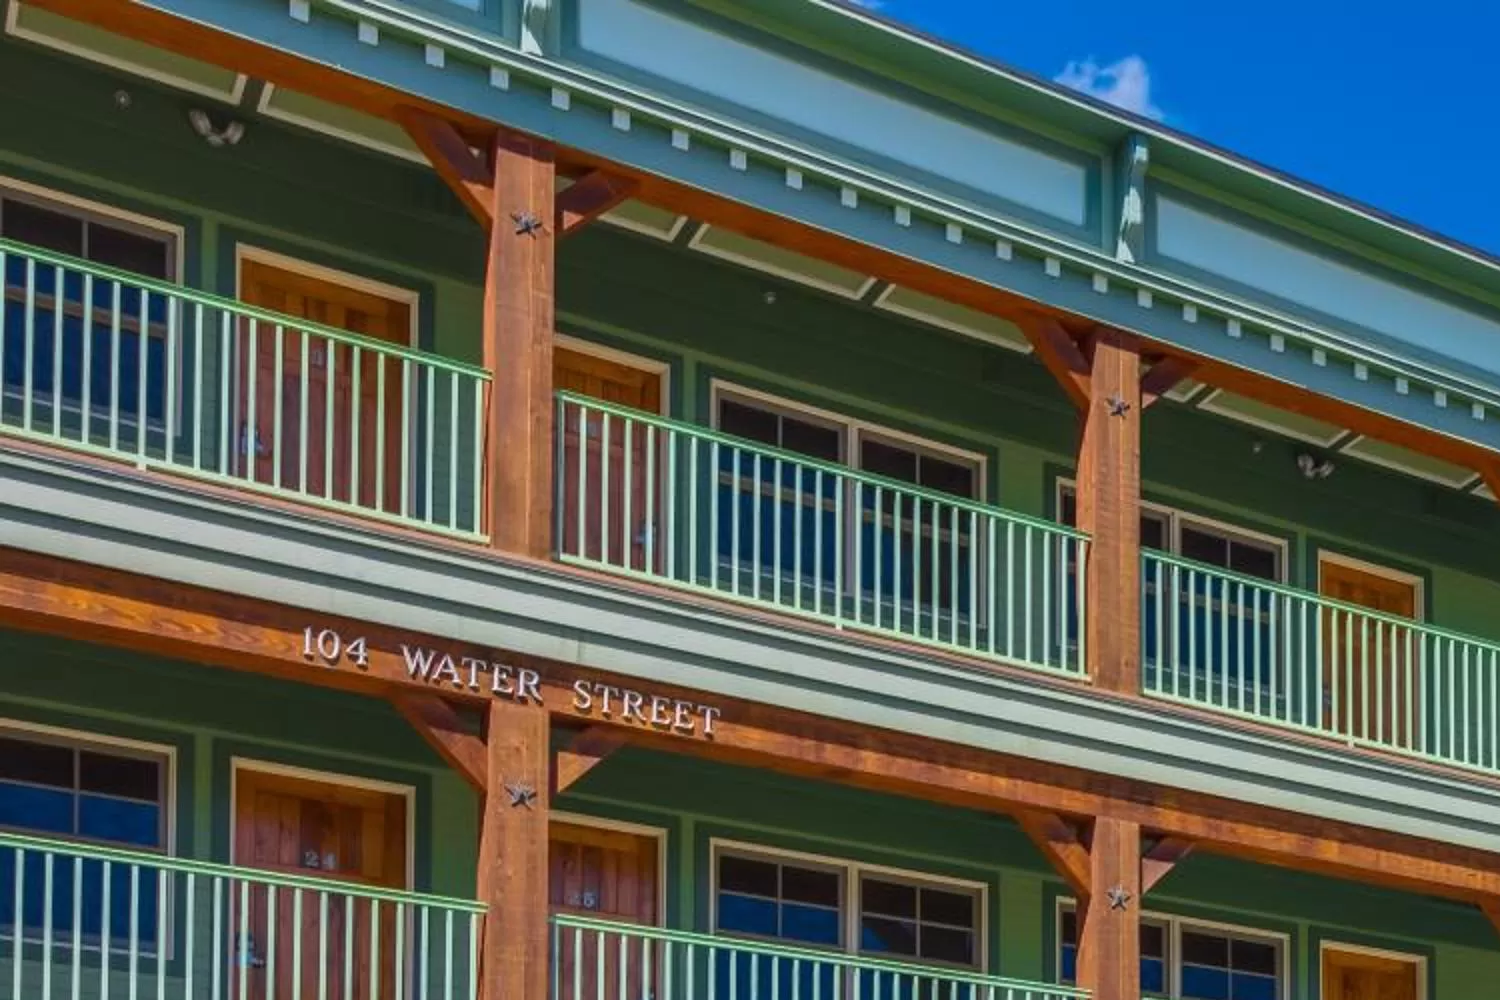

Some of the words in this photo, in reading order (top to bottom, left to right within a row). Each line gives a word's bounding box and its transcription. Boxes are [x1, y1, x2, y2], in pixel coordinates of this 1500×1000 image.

[302, 626, 369, 668] 104
[400, 644, 543, 703] WATER
[573, 679, 720, 736] STREET
